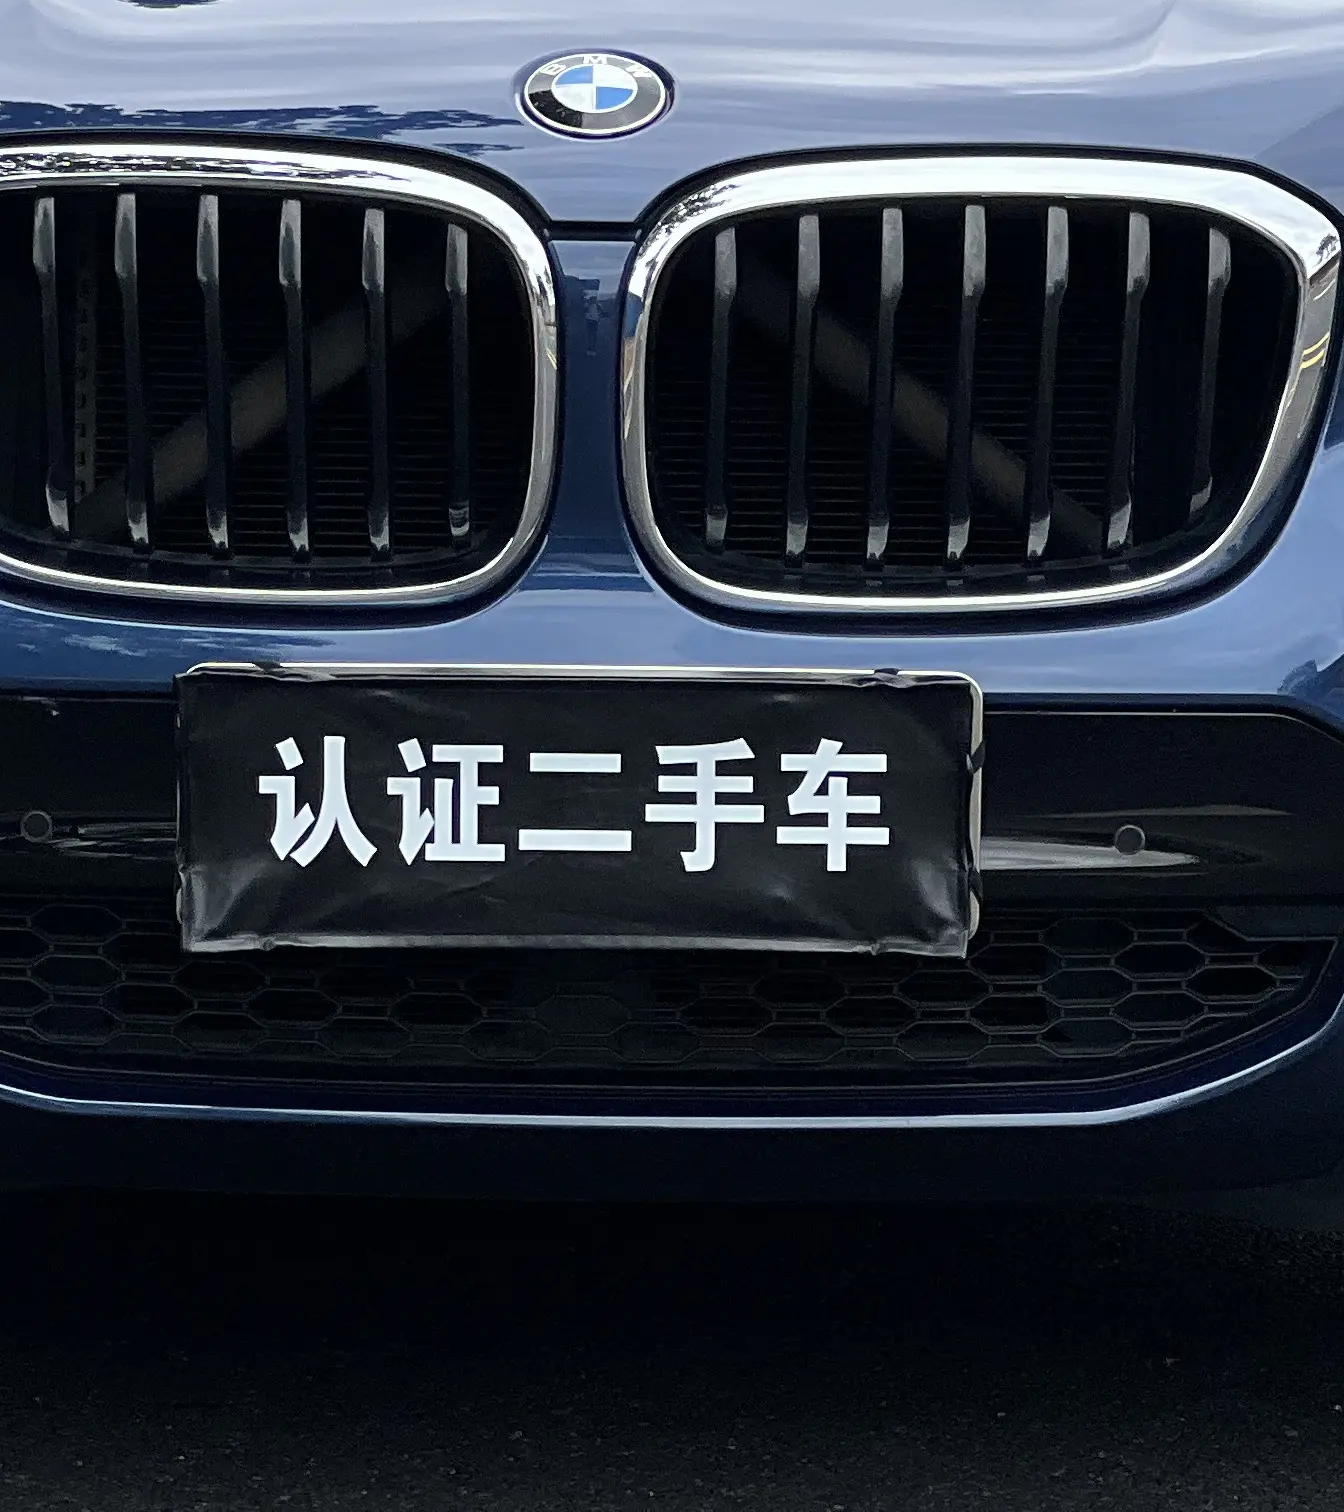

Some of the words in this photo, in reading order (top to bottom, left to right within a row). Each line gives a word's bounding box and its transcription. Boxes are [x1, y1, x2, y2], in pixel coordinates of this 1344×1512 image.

[540, 55, 653, 78] BMW
[258, 735, 890, 872] 认证二手车
